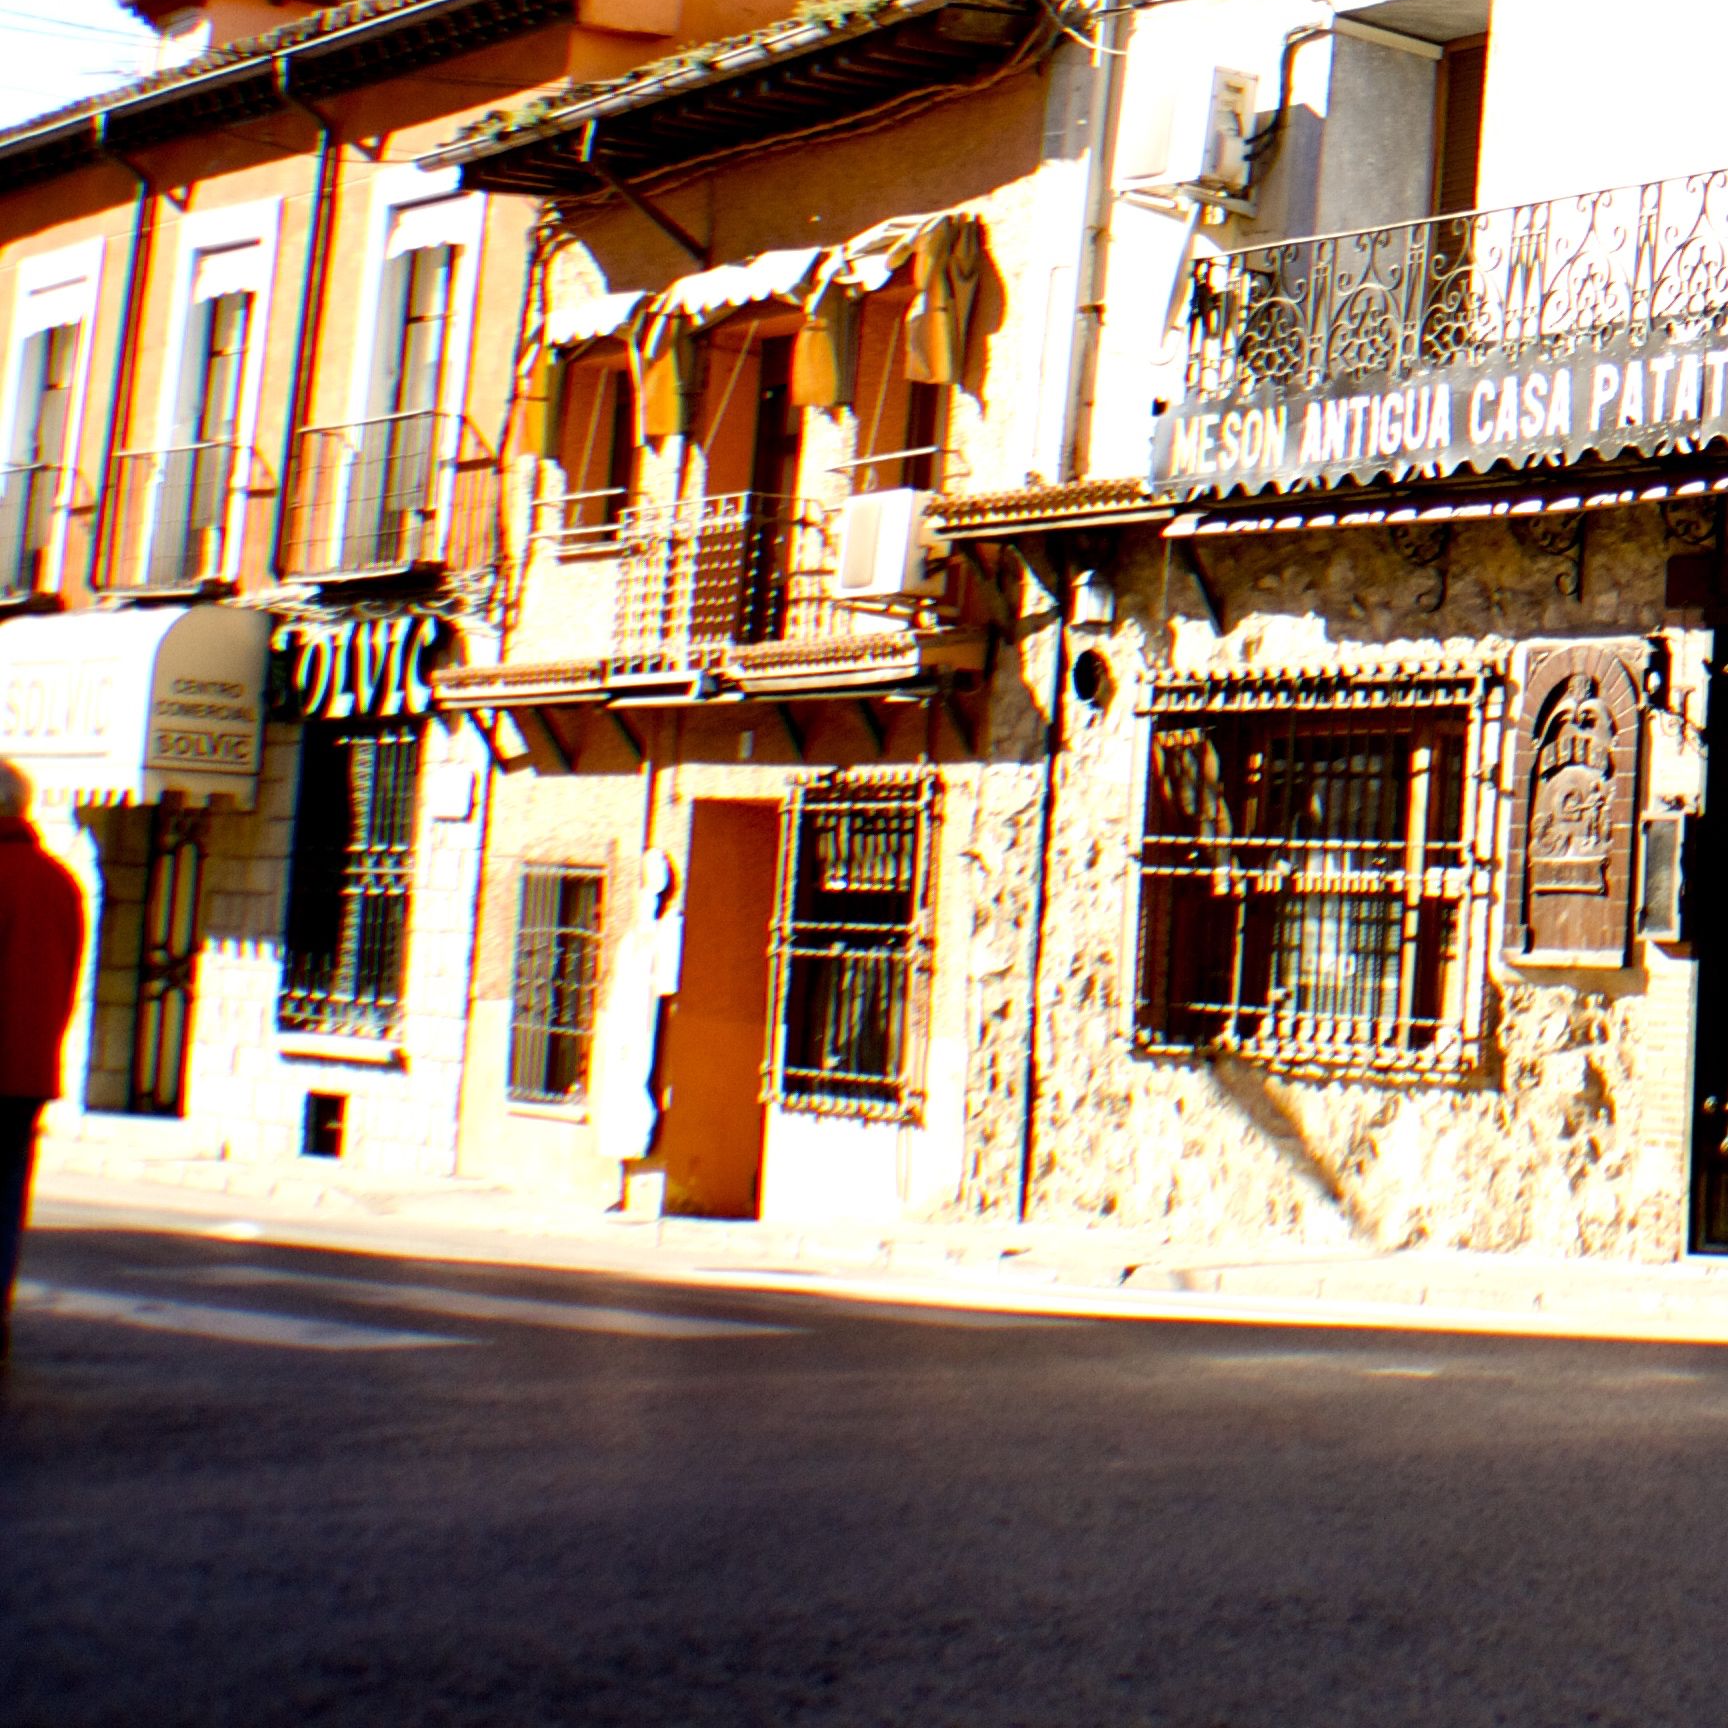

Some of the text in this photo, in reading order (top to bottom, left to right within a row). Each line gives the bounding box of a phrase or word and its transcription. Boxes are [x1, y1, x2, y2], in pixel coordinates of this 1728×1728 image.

[1169, 404, 1288, 476] MESON
[1300, 383, 1450, 464] ANTIGUA
[1468, 367, 1573, 445] CASA
[156, 732, 250, 760] SOLVIC
